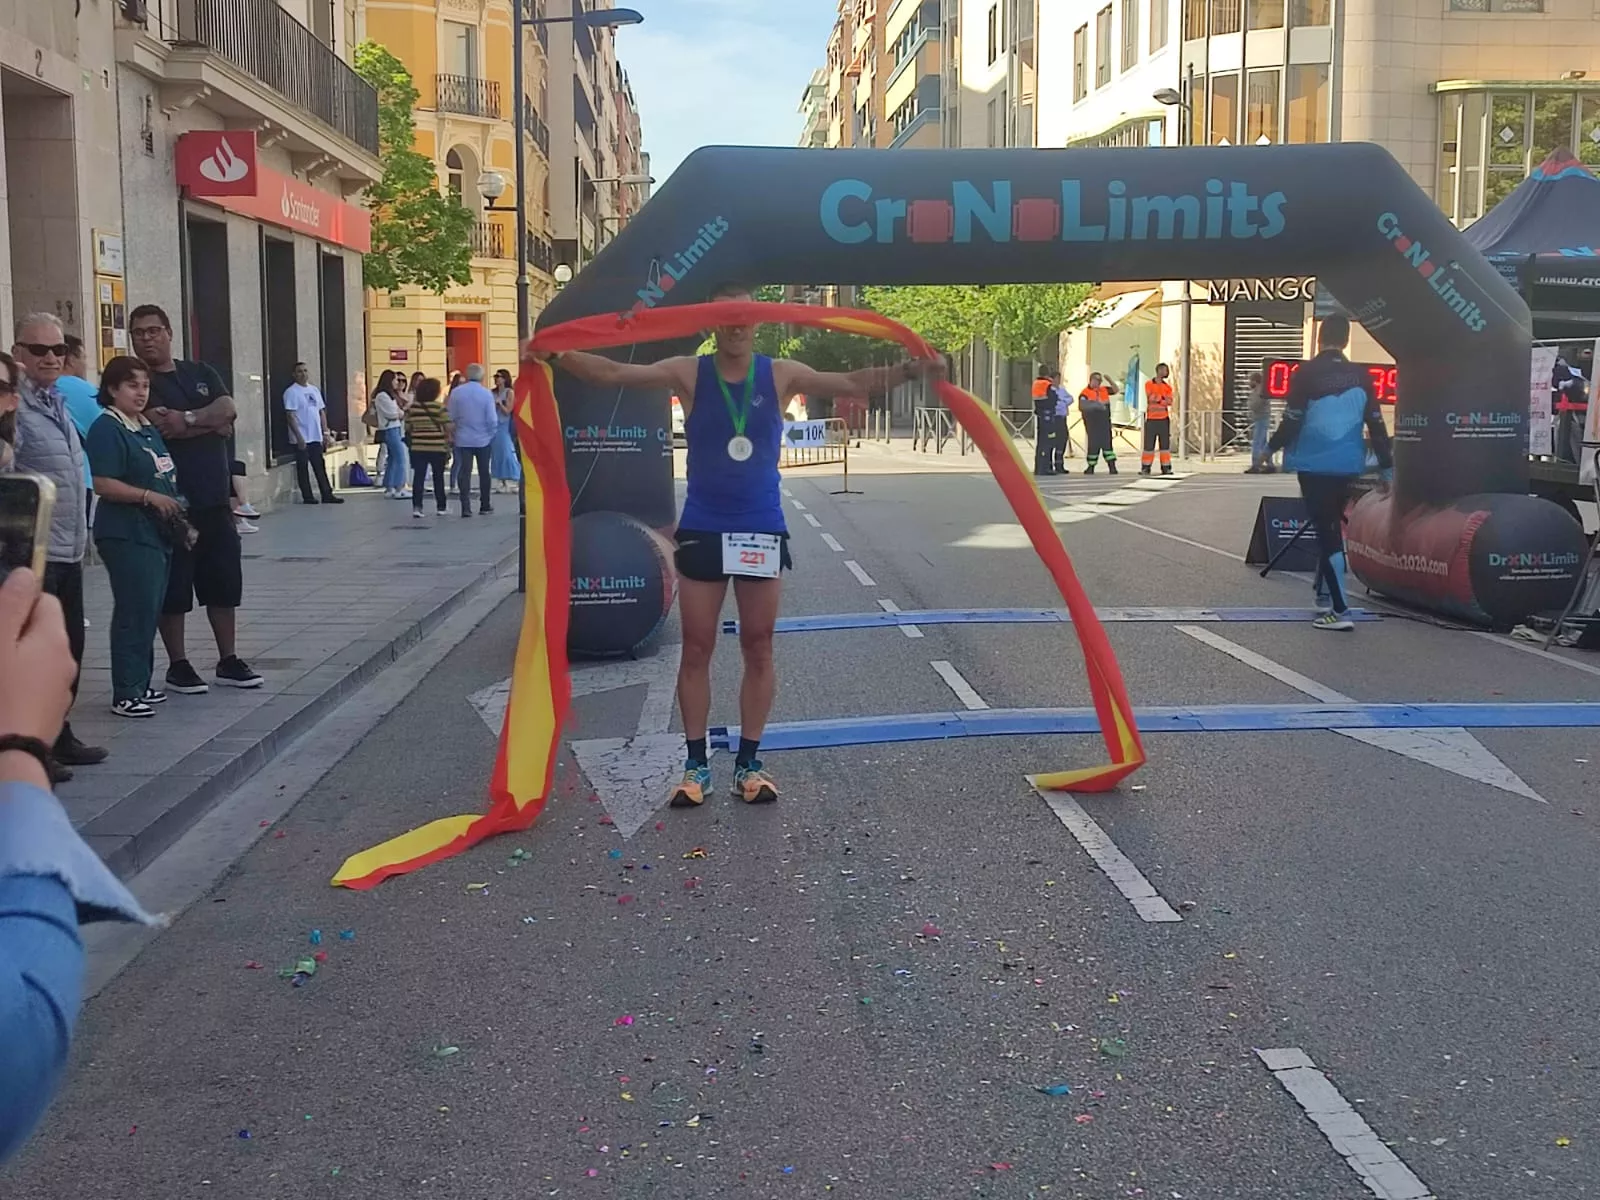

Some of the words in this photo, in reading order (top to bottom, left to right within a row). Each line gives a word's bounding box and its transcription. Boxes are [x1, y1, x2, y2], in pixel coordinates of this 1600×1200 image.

[34, 47, 44, 78] 2
[289, 191, 320, 228] Santander
[804, 424, 825, 441] 10K
[739, 550, 766, 565] 221
